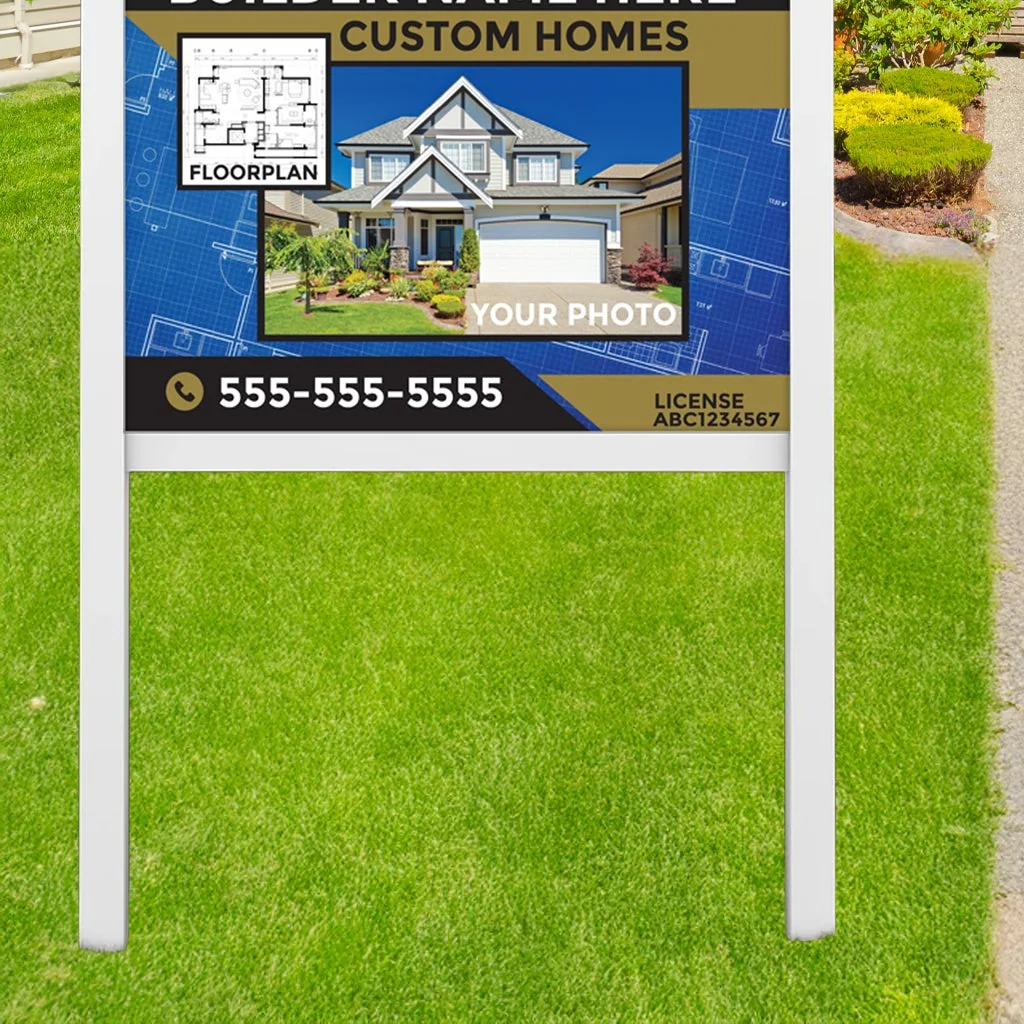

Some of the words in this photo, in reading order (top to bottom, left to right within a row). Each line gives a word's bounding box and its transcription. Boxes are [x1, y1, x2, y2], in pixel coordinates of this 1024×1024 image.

[339, 20, 520, 52] CUSTOM
[536, 20, 689, 52] HOMES
[190, 164, 318, 181] FLOORPLAN
[471, 302, 558, 327] YOUR
[568, 302, 677, 327] PHOTO
[219, 376, 503, 409] 555-555-5555
[655, 392, 745, 410] LICENSE
[652, 411, 781, 428] ABC1234567
